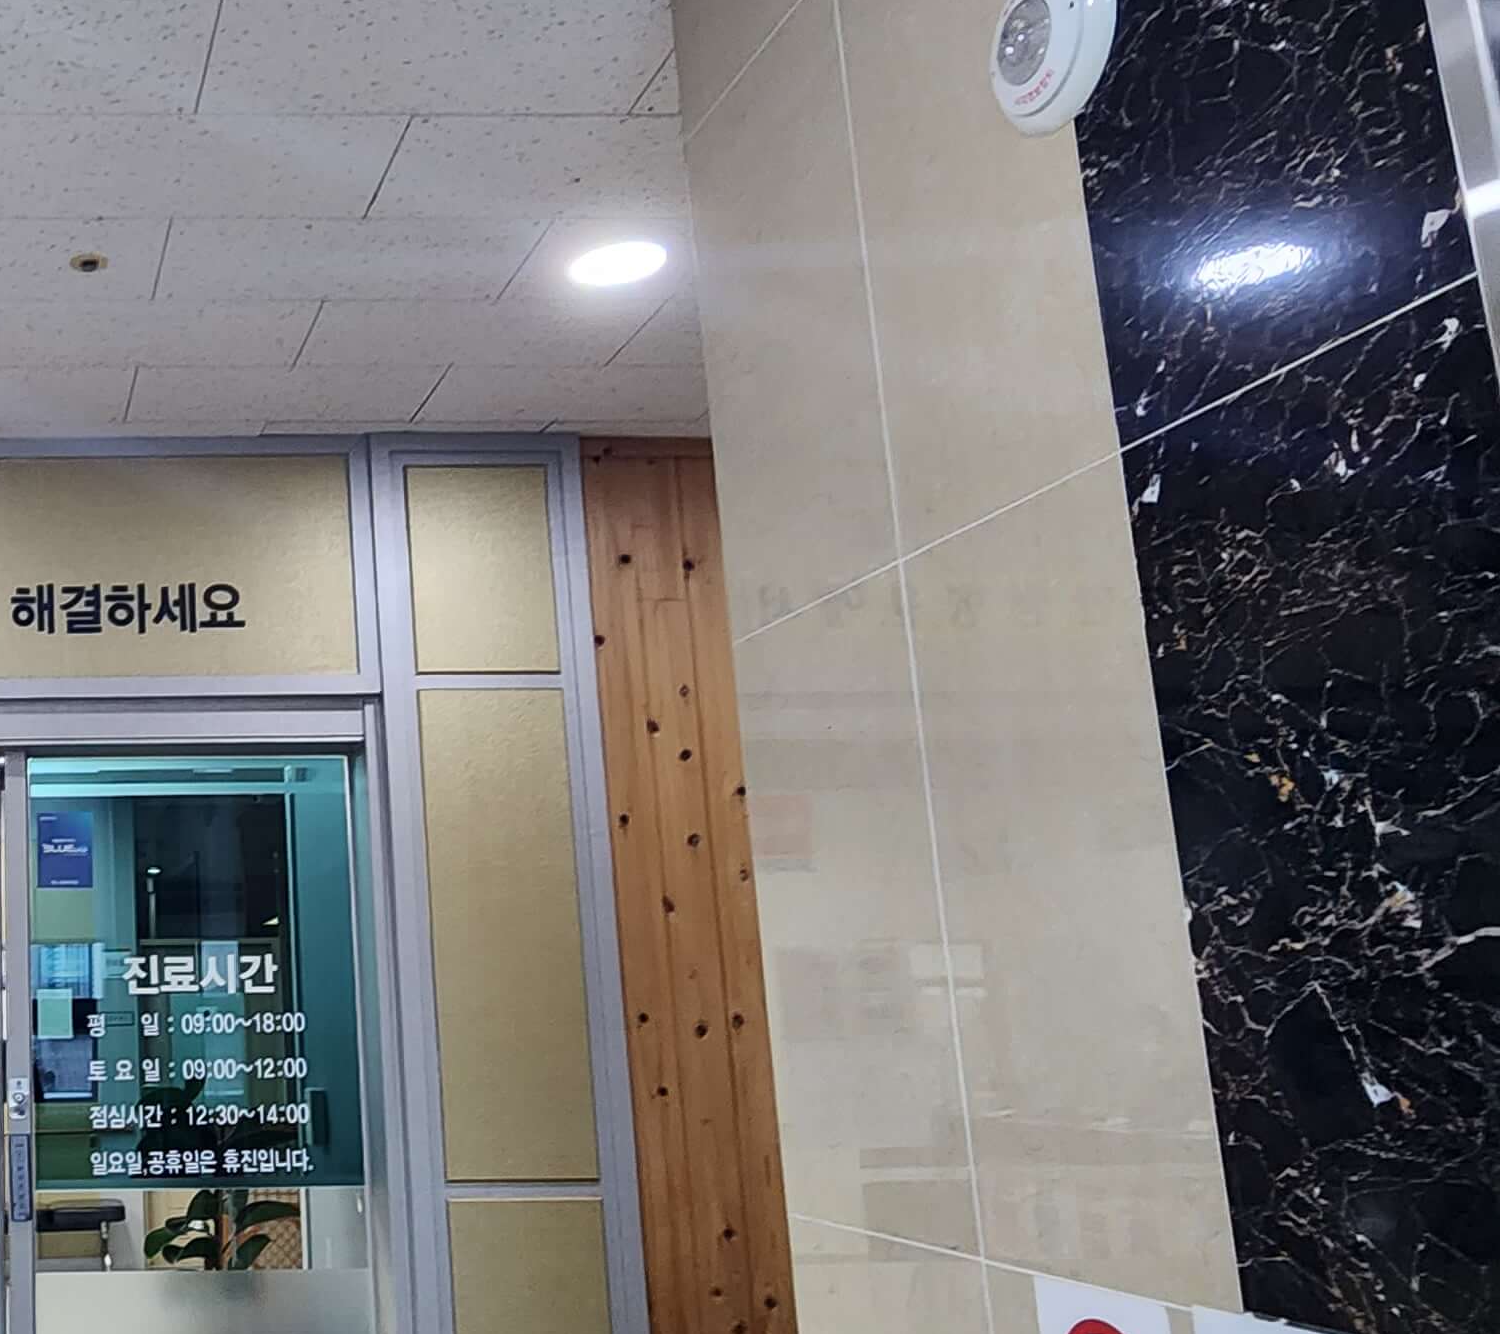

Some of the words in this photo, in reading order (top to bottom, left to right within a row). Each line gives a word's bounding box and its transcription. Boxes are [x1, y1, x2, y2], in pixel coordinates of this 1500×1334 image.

[10, 583, 246, 635] 해결하세요
[122, 953, 279, 995] 진료시간
[181, 1012, 306, 1037] 09:00~18:00
[181, 1058, 308, 1082] 09:00~12:00
[89, 1104, 162, 1130] 점심시간
[186, 1103, 309, 1127] 12:30~14:00
[222, 1147, 315, 1175] 휴진입니다.
